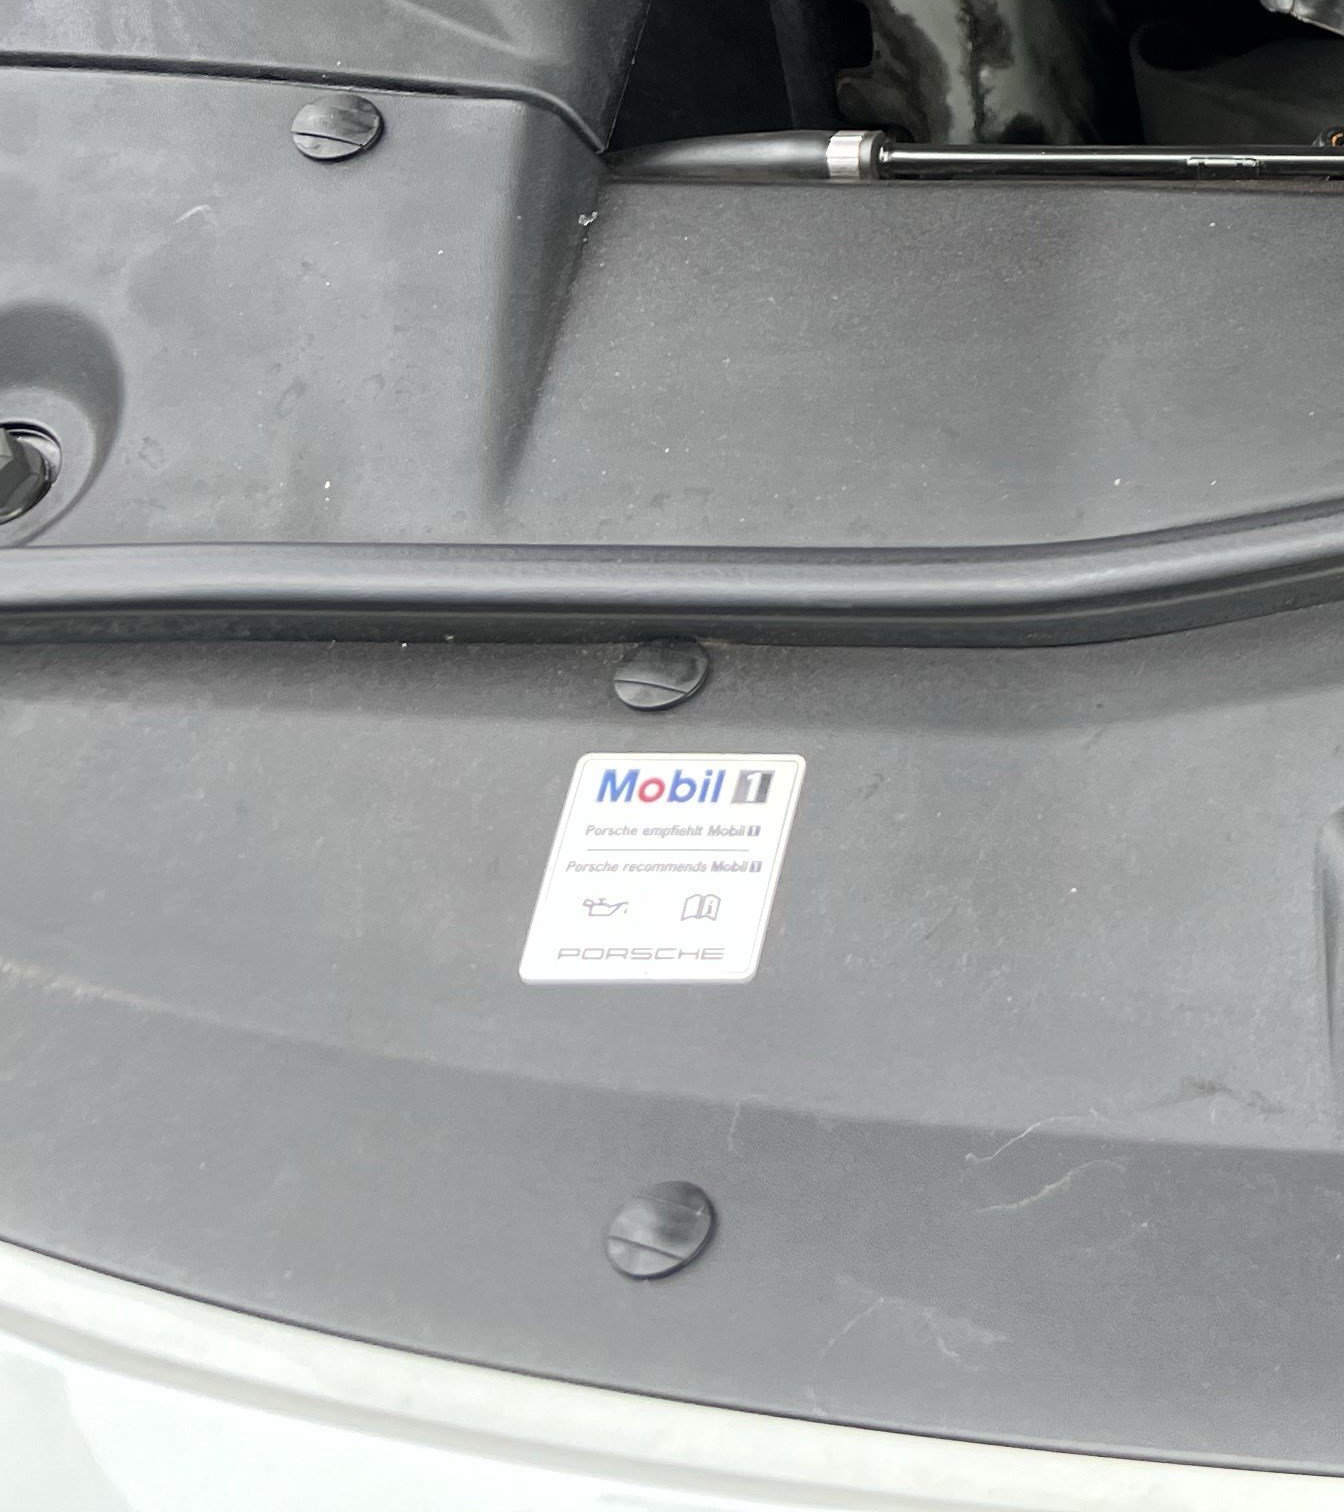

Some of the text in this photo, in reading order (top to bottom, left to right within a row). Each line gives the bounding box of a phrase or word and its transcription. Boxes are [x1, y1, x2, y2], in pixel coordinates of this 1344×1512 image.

[595, 768, 770, 804] Mobil 1
[585, 824, 638, 837] Porsche
[642, 825, 704, 838] empfiehlt
[707, 825, 746, 837] Mobil
[565, 860, 619, 873] Porsche
[623, 861, 707, 873] recommends
[710, 860, 748, 873] Mobil
[556, 947, 726, 961] PORSCHE
